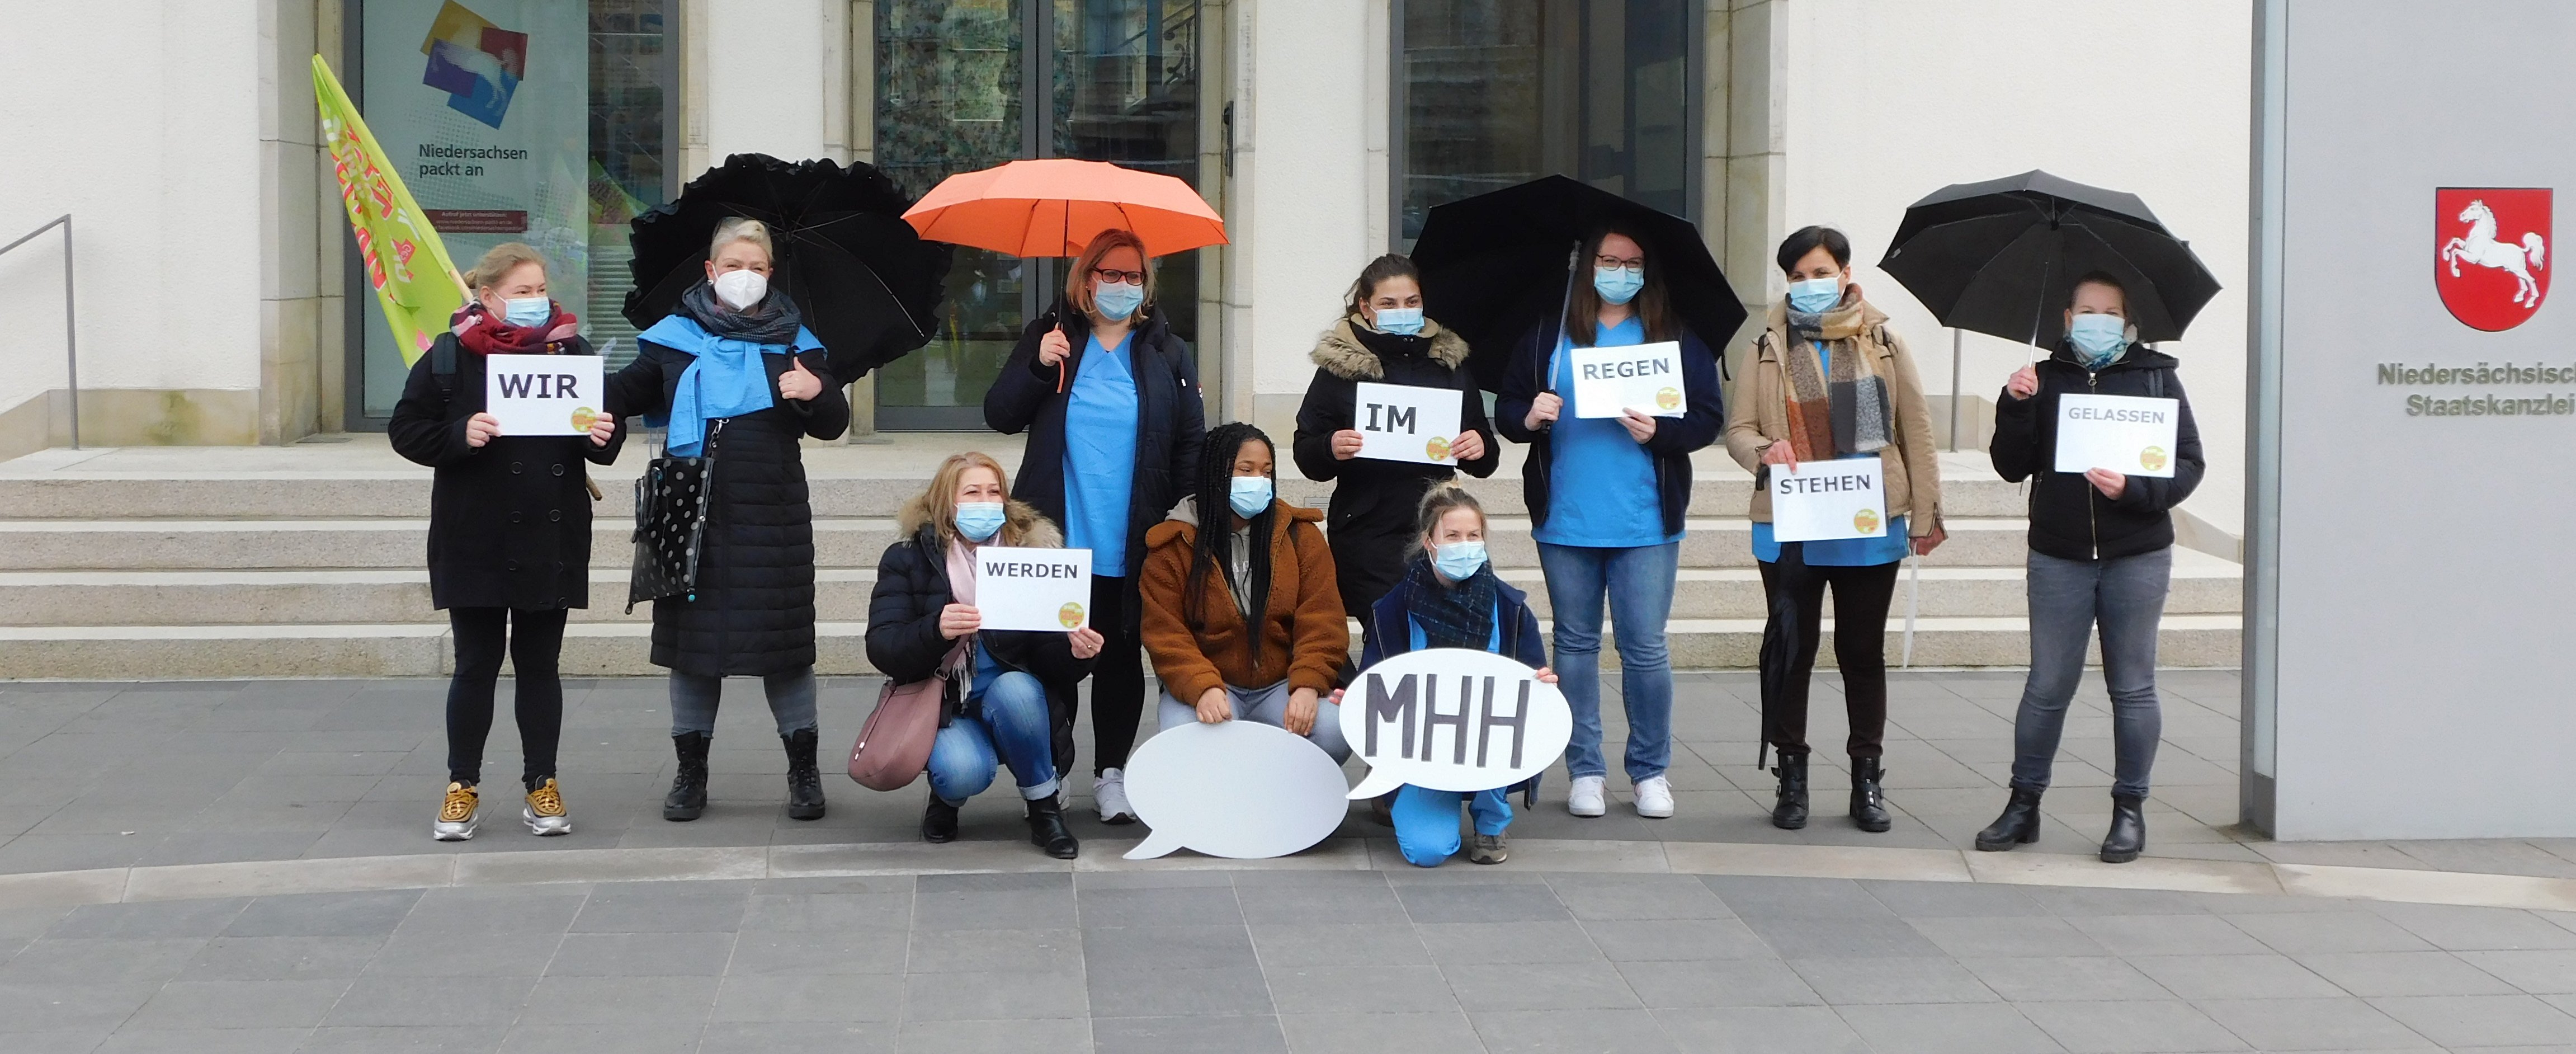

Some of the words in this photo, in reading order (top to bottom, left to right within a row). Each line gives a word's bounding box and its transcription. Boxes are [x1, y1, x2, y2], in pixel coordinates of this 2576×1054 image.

[419, 144, 527, 159] Niedersachsen
[419, 162, 460, 178] packt
[465, 166, 484, 176] an
[1583, 357, 1670, 380] REGEN
[2378, 361, 2576, 384] Niedersächsisc
[497, 374, 579, 398] WIR
[2069, 407, 2164, 424] GELASSEN
[2407, 393, 2575, 416] Staatskanzlei
[1365, 403, 1417, 435] IM
[1780, 474, 1871, 494] STEHEN
[985, 562, 1078, 578] WERDEN
[1365, 673, 1532, 769] MHH
